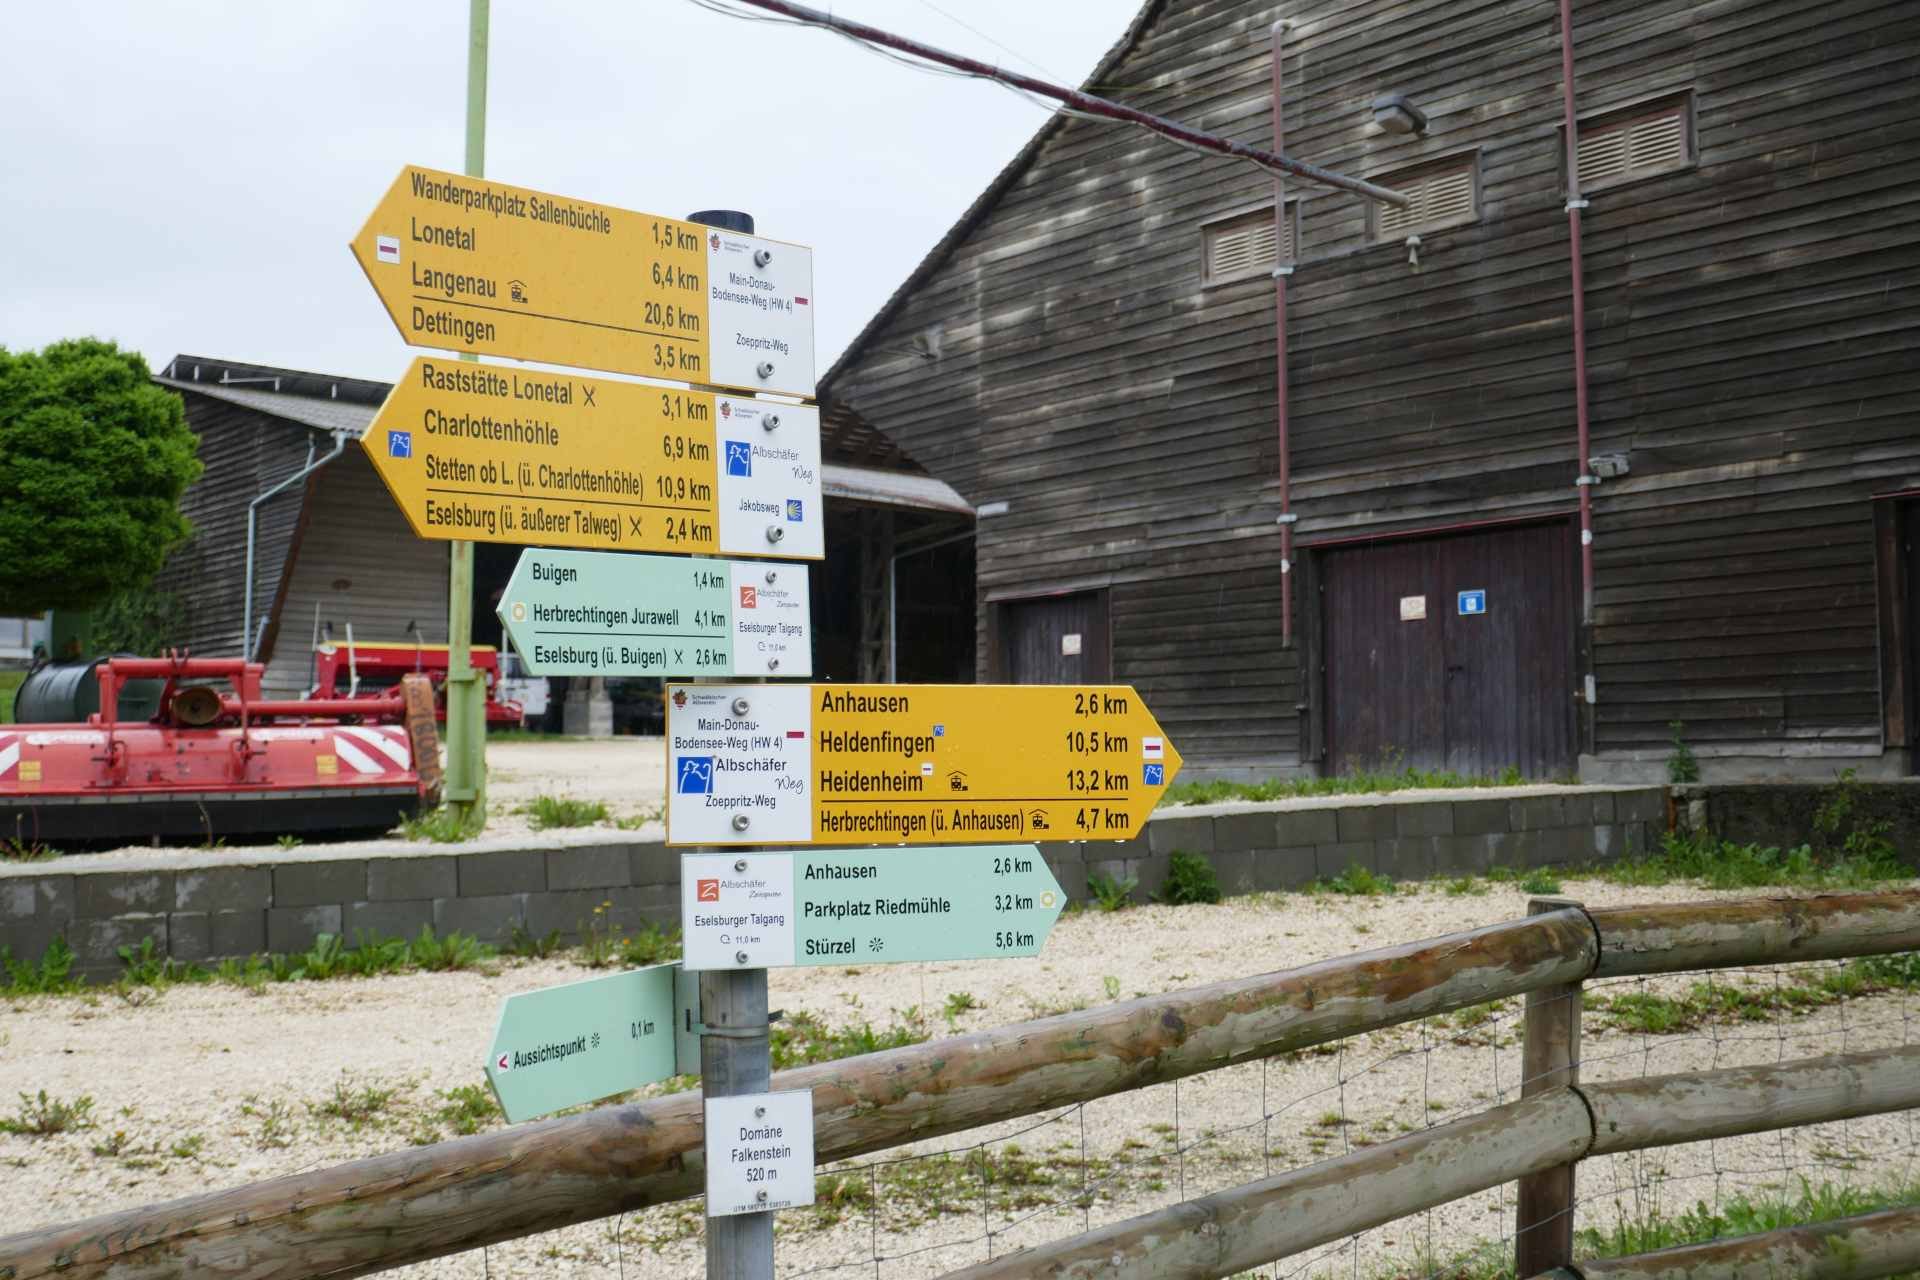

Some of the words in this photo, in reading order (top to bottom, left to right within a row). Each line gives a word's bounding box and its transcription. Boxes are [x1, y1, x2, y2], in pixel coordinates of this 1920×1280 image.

[412, 172, 526, 218] Wanderparkplatz
[530, 197, 611, 234] Sallenbüchle
[652, 223, 672, 248] 1,5
[677, 227, 698, 251] km
[412, 217, 476, 251] Lonetal
[653, 262, 673, 287] 6,4
[678, 267, 699, 291] km
[729, 272, 775, 291] Main-Donau-
[412, 261, 497, 298] Langenau
[644, 302, 674, 328] 20,6
[679, 307, 700, 331] km
[712, 287, 768, 310] Bodensee-Weg
[769, 297, 784, 312] (HW
[785, 301, 793, 314] 4)
[413, 306, 495, 343] Dettingen
[654, 344, 675, 371] 3,5
[680, 348, 700, 371] km
[736, 333, 789, 356] Zoeppritz-Weg
[423, 364, 508, 397] Raststätte
[514, 376, 572, 405] Lonetal
[663, 394, 681, 419] 3,1
[687, 396, 708, 421] km
[424, 409, 559, 447] Charlottenhöhle
[663, 436, 683, 461] 6,9
[689, 438, 709, 461] km
[426, 454, 475, 481] Stetten
[480, 459, 497, 482] ob
[501, 461, 514, 485] L.
[518, 463, 535, 492] (ü.
[538, 466, 644, 502] Charlottenhöhle)
[656, 476, 685, 500] 10,9
[690, 478, 710, 501] km
[739, 499, 780, 516] Jakobsweg
[426, 500, 496, 535] Eselsburg
[500, 505, 517, 536] (ü.
[521, 507, 570, 533] äußerer
[574, 510, 622, 542] Talweg)
[666, 518, 686, 544] 2,4
[691, 519, 712, 542] km
[533, 563, 577, 586] Buigen
[694, 572, 707, 590] 1,4
[710, 573, 724, 588] km
[534, 604, 628, 628] Herbrechtingen
[632, 608, 679, 626] Jurawell
[695, 611, 708, 629] 4,1
[712, 612, 725, 627] km
[739, 622, 777, 636] Eselsburger
[779, 623, 802, 636] Talgang
[535, 646, 598, 668] Eselsburg
[602, 647, 617, 668] (ü.
[621, 648, 667, 669] Buigen)
[696, 650, 710, 666] 2,6
[712, 650, 727, 666] km
[821, 691, 909, 713] Anhausen
[1075, 693, 1098, 717] 2,6
[1104, 693, 1127, 714] km
[698, 718, 760, 731] Main-Donau-
[675, 737, 748, 751] Bodensee-Weg
[751, 737, 771, 751] (HW
[773, 737, 783, 751] 4)
[820, 731, 934, 758] Heldenfingen
[1066, 732, 1099, 756] 10,5
[1105, 732, 1128, 753] km
[715, 758, 787, 772] Albschäfer
[775, 776, 804, 795] Weg
[820, 770, 923, 792] Heidenheim
[1066, 770, 1099, 794] 13,2
[1105, 771, 1128, 791] km
[705, 795, 776, 809] Zoeppritz-Weg
[820, 810, 926, 836] Herbrechtingen
[931, 809, 948, 836] (ü.
[952, 809, 1024, 836] Anhausen)
[1076, 809, 1099, 832] 4,7
[1105, 808, 1129, 829] km
[805, 864, 877, 880] Anhausen
[994, 858, 1011, 876] 2,6
[1015, 857, 1032, 873] km
[805, 900, 871, 920] Parkplatz
[875, 898, 951, 915] Riedmühle
[995, 895, 1012, 913] 3,2
[1016, 894, 1033, 910] km
[695, 915, 748, 928] Eselsburger
[751, 914, 785, 927] Talgang
[806, 938, 856, 955] Stürzel
[996, 932, 1013, 950] 5,6
[1017, 931, 1034, 947] km
[513, 1036, 586, 1069] Aussichtspunkt
[631, 1022, 642, 1039] 0,1
[644, 1020, 655, 1034] km
[740, 1126, 783, 1141] Domäne
[731, 1145, 791, 1163] Falkenstein
[746, 1168, 765, 1182] 520
[767, 1169, 777, 1180] m
